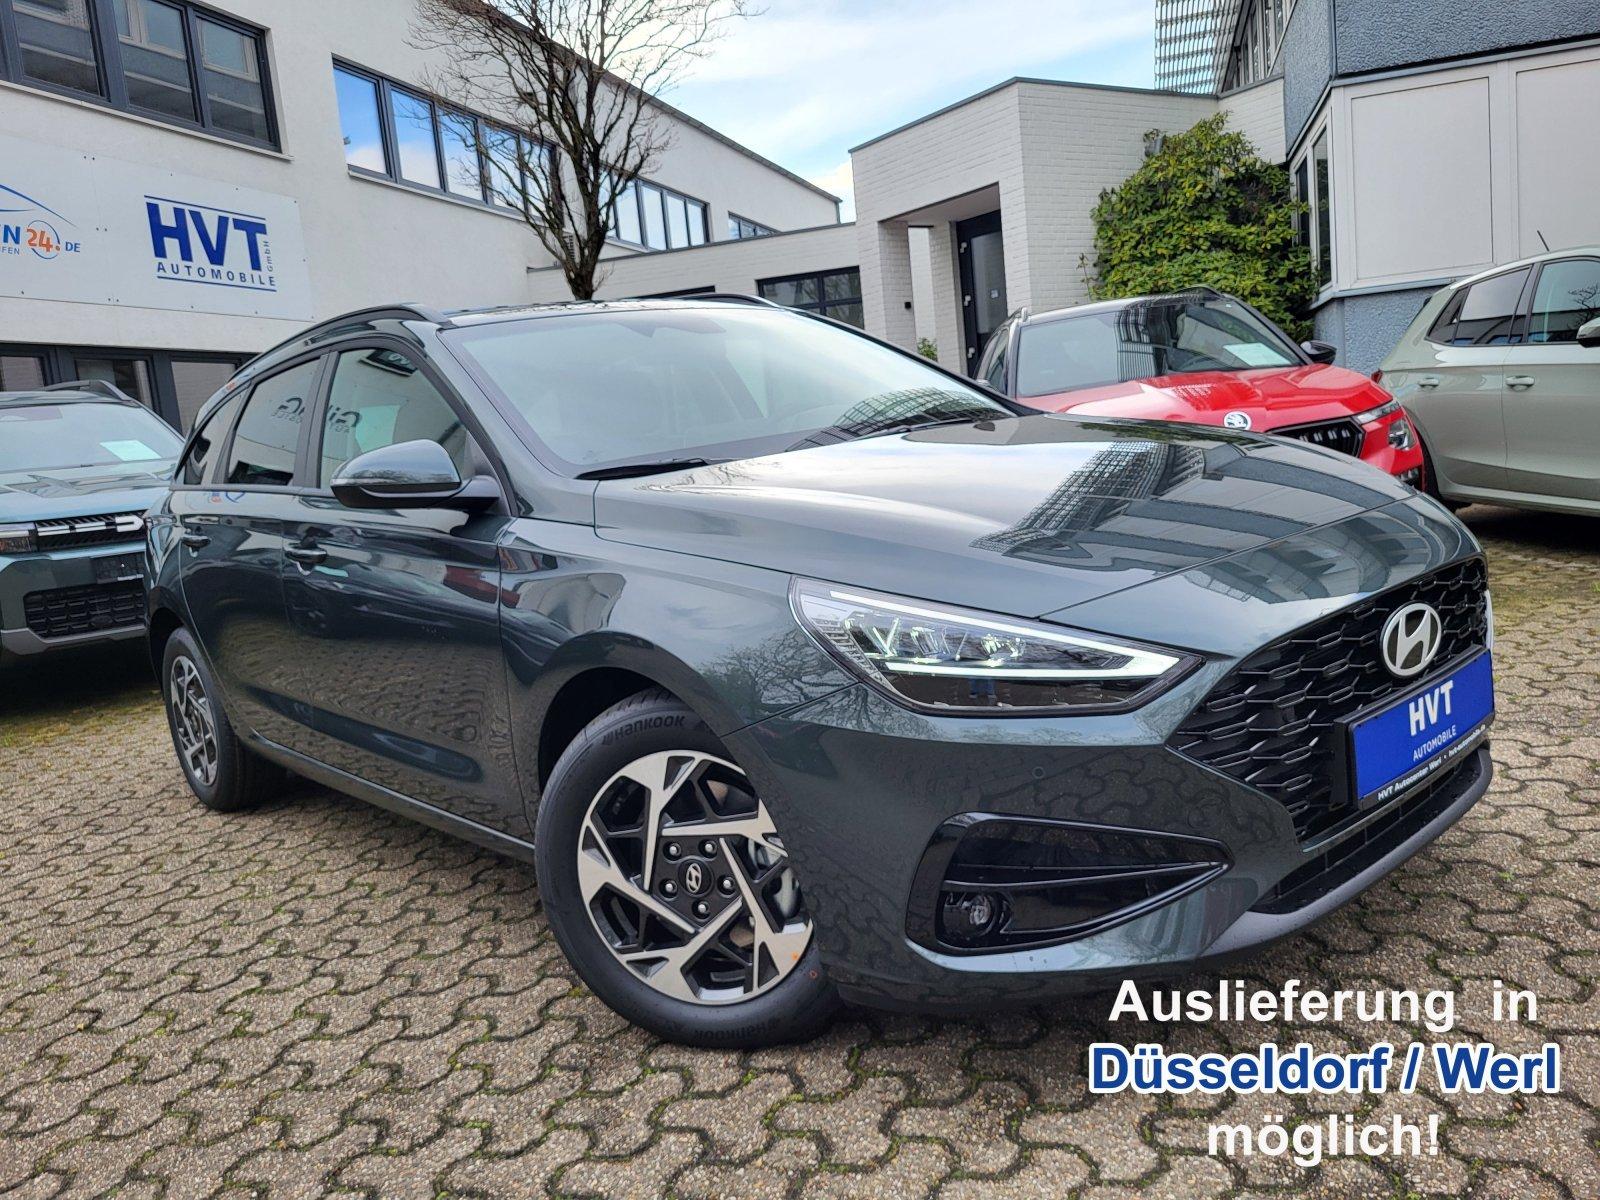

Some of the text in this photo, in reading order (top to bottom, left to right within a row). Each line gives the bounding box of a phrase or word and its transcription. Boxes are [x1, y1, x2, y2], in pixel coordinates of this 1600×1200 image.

[146, 201, 267, 272] HVT
[157, 261, 277, 287] AUTOMOBILE
[263, 240, 274, 272] GmbH
[1408, 680, 1454, 737] HVT
[1413, 724, 1457, 762] AUTOMOBILE
